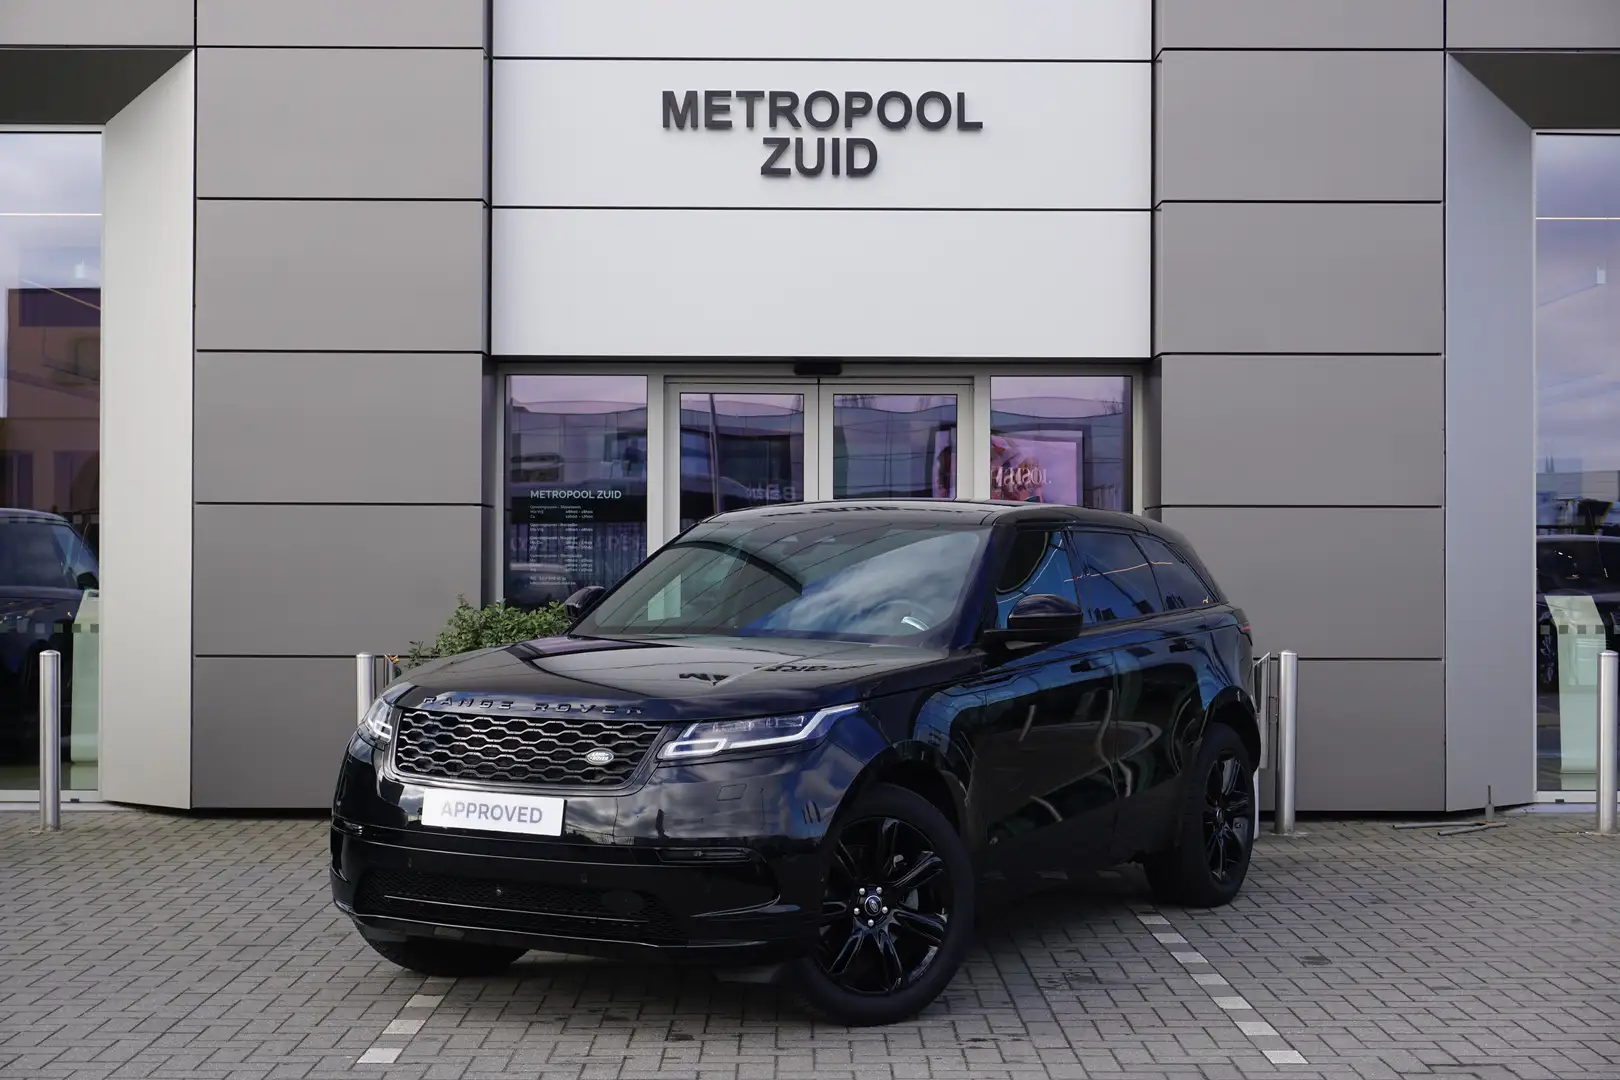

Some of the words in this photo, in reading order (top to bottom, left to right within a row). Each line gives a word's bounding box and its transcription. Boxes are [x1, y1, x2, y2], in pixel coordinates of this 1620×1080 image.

[662, 90, 983, 130] METROPOOL
[760, 137, 878, 176] ZUID
[530, 490, 595, 499] METROPOOL
[596, 490, 622, 499] ZUID
[422, 697, 514, 710] RANGE
[532, 702, 645, 715] ROVER
[440, 802, 543, 824] APPROVED
